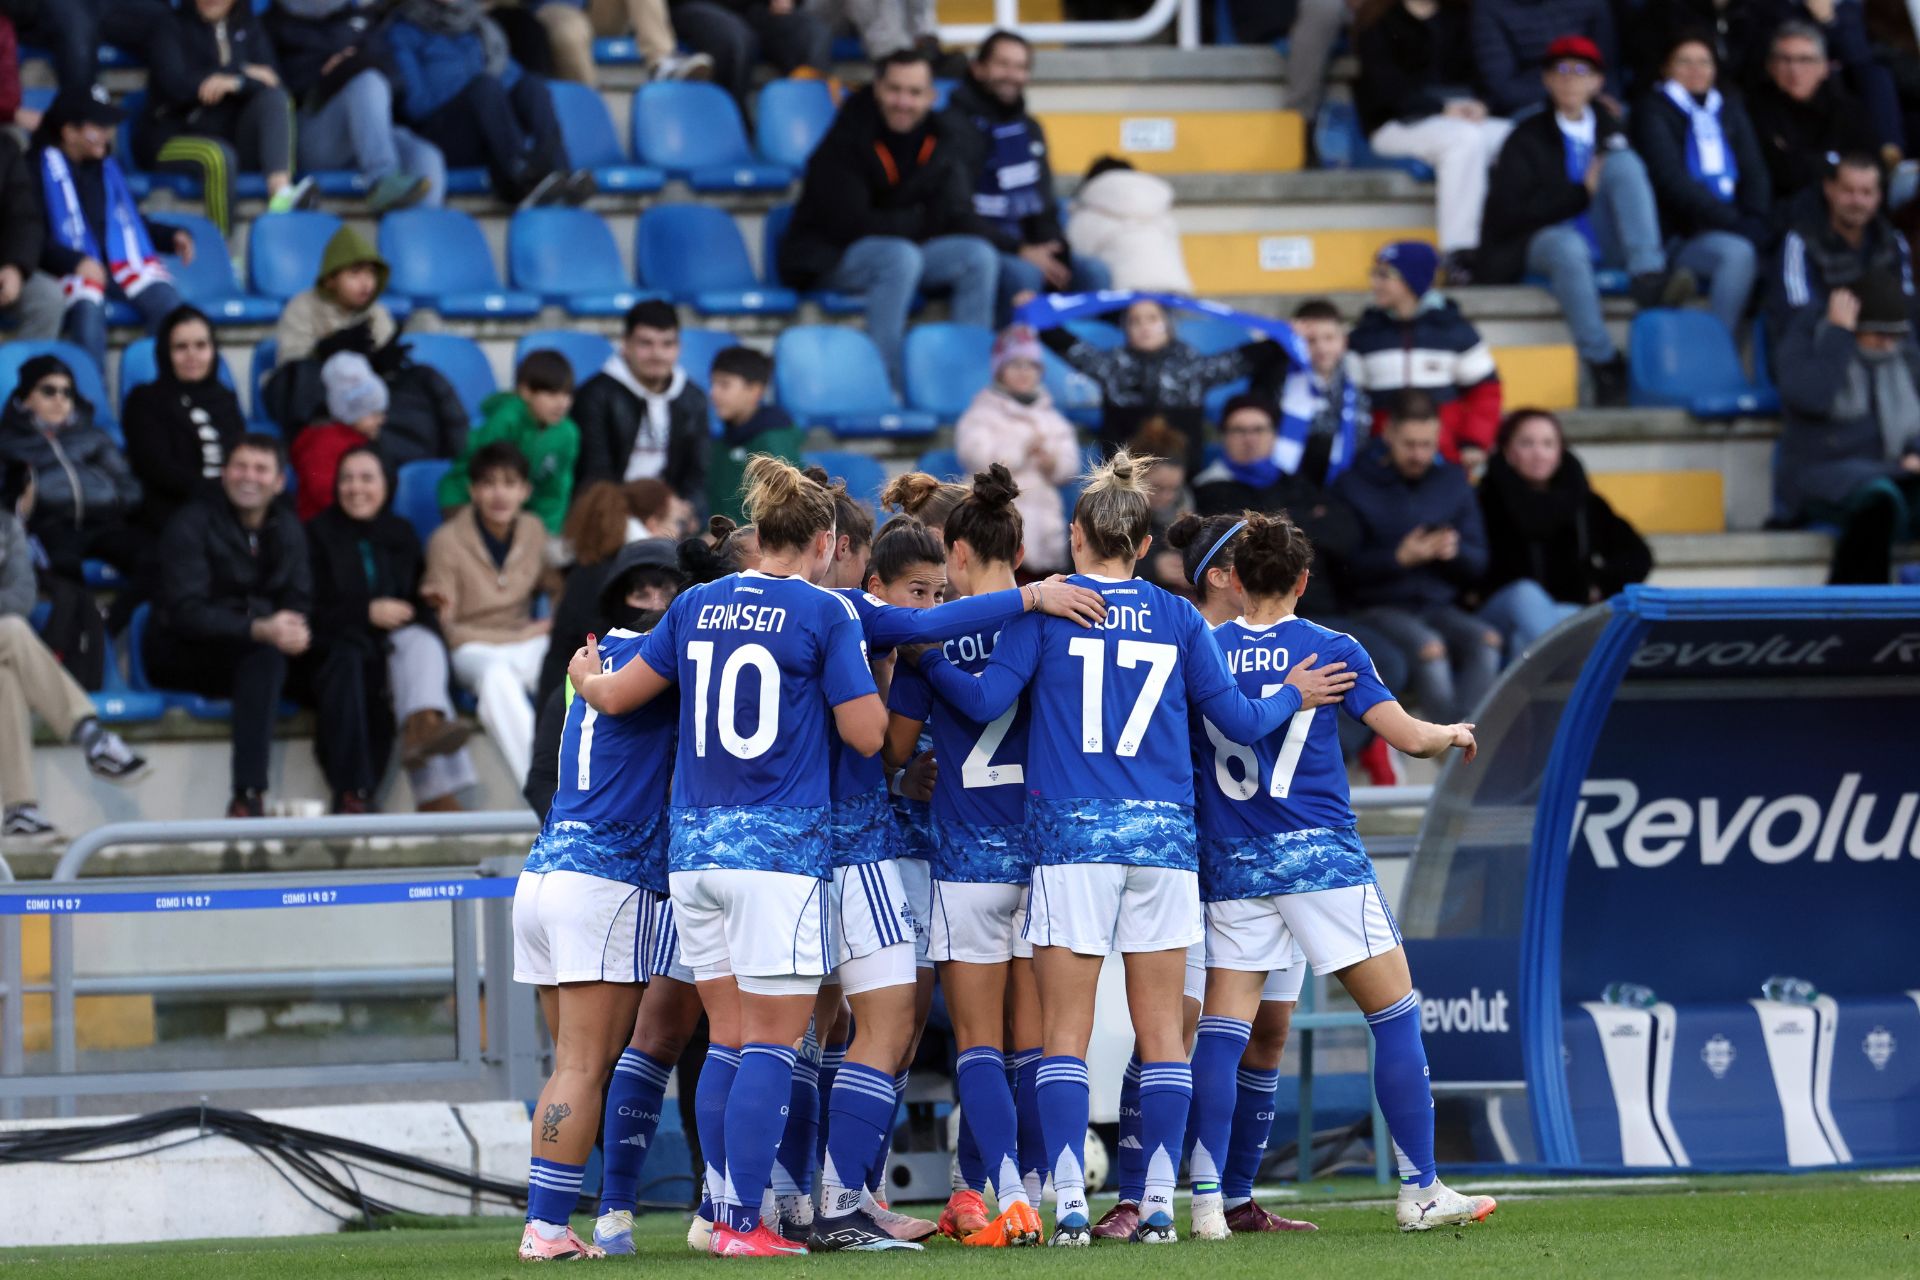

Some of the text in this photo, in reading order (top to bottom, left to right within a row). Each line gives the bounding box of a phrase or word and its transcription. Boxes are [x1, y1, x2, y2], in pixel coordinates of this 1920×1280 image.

[696, 603, 786, 633] ERIKSEN
[1227, 647, 1290, 675] VERO
[1628, 634, 1843, 668] evolut
[687, 640, 781, 760] 10
[1068, 636, 1178, 757] 17
[1567, 772, 1920, 868] Revolu
[26, 899, 50, 910] COMO
[156, 897, 180, 908] COMO
[282, 893, 306, 905] COMO
[409, 887, 433, 898] COMO
[541, 1125, 559, 1142] 22
